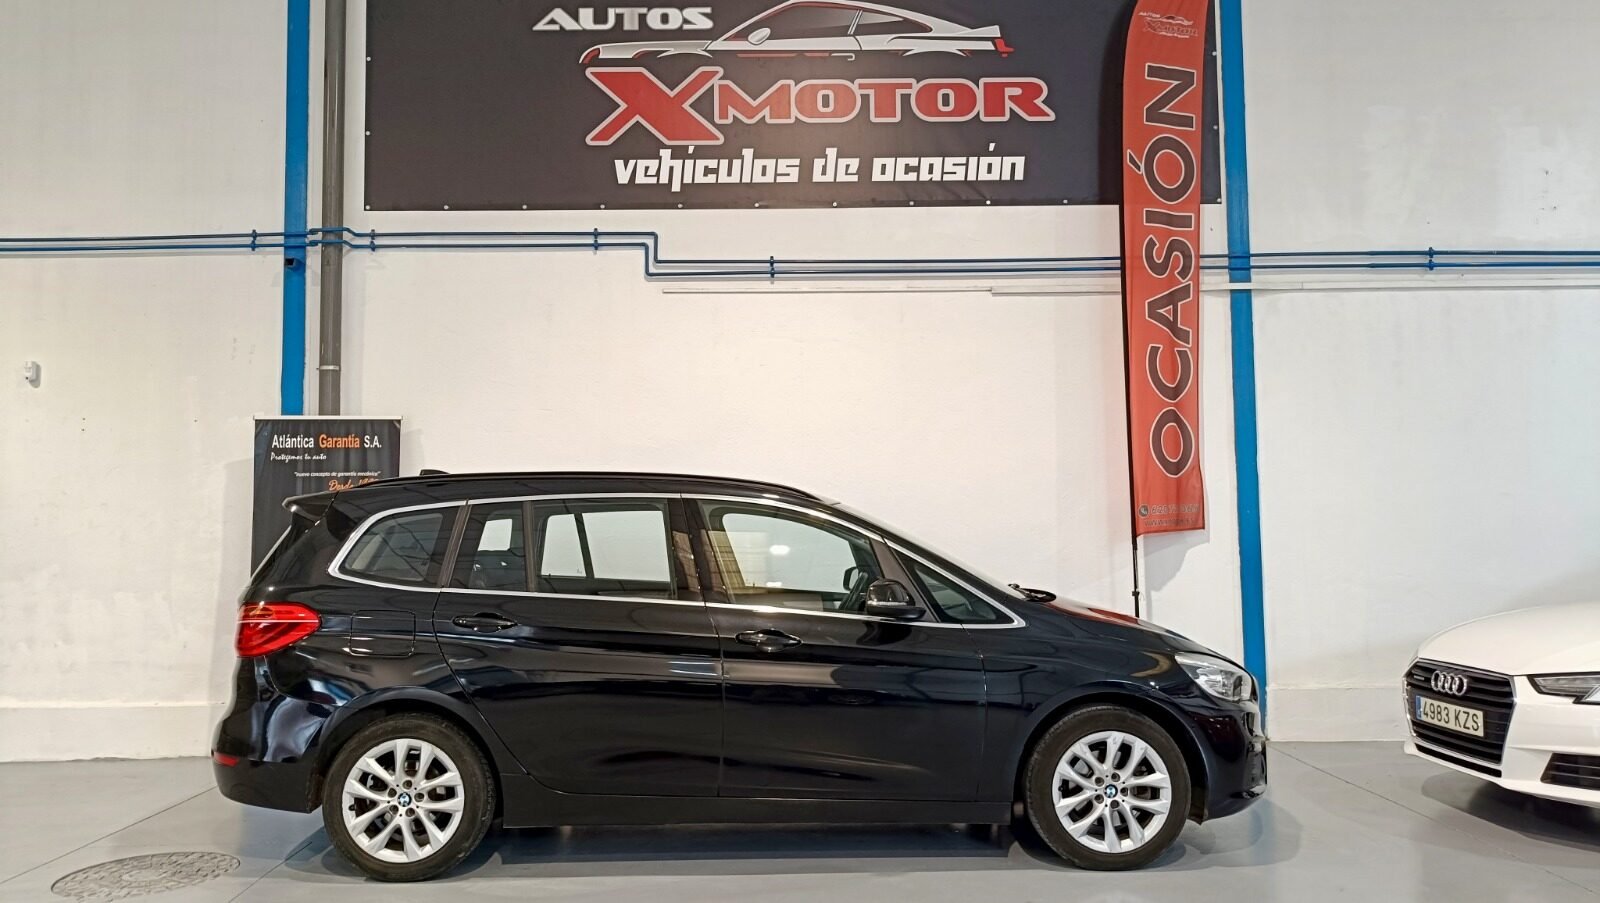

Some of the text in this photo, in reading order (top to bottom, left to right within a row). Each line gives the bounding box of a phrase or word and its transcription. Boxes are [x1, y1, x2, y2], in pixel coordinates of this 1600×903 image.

[532, 6, 714, 31] AUTOS
[614, 142, 1025, 192] vehículos de ocasión
[1127, 62, 1197, 478] OCASIÓN
[271, 433, 382, 449] Atlántica Garantía S.A.
[1422, 700, 1481, 732] 4983 KZS
